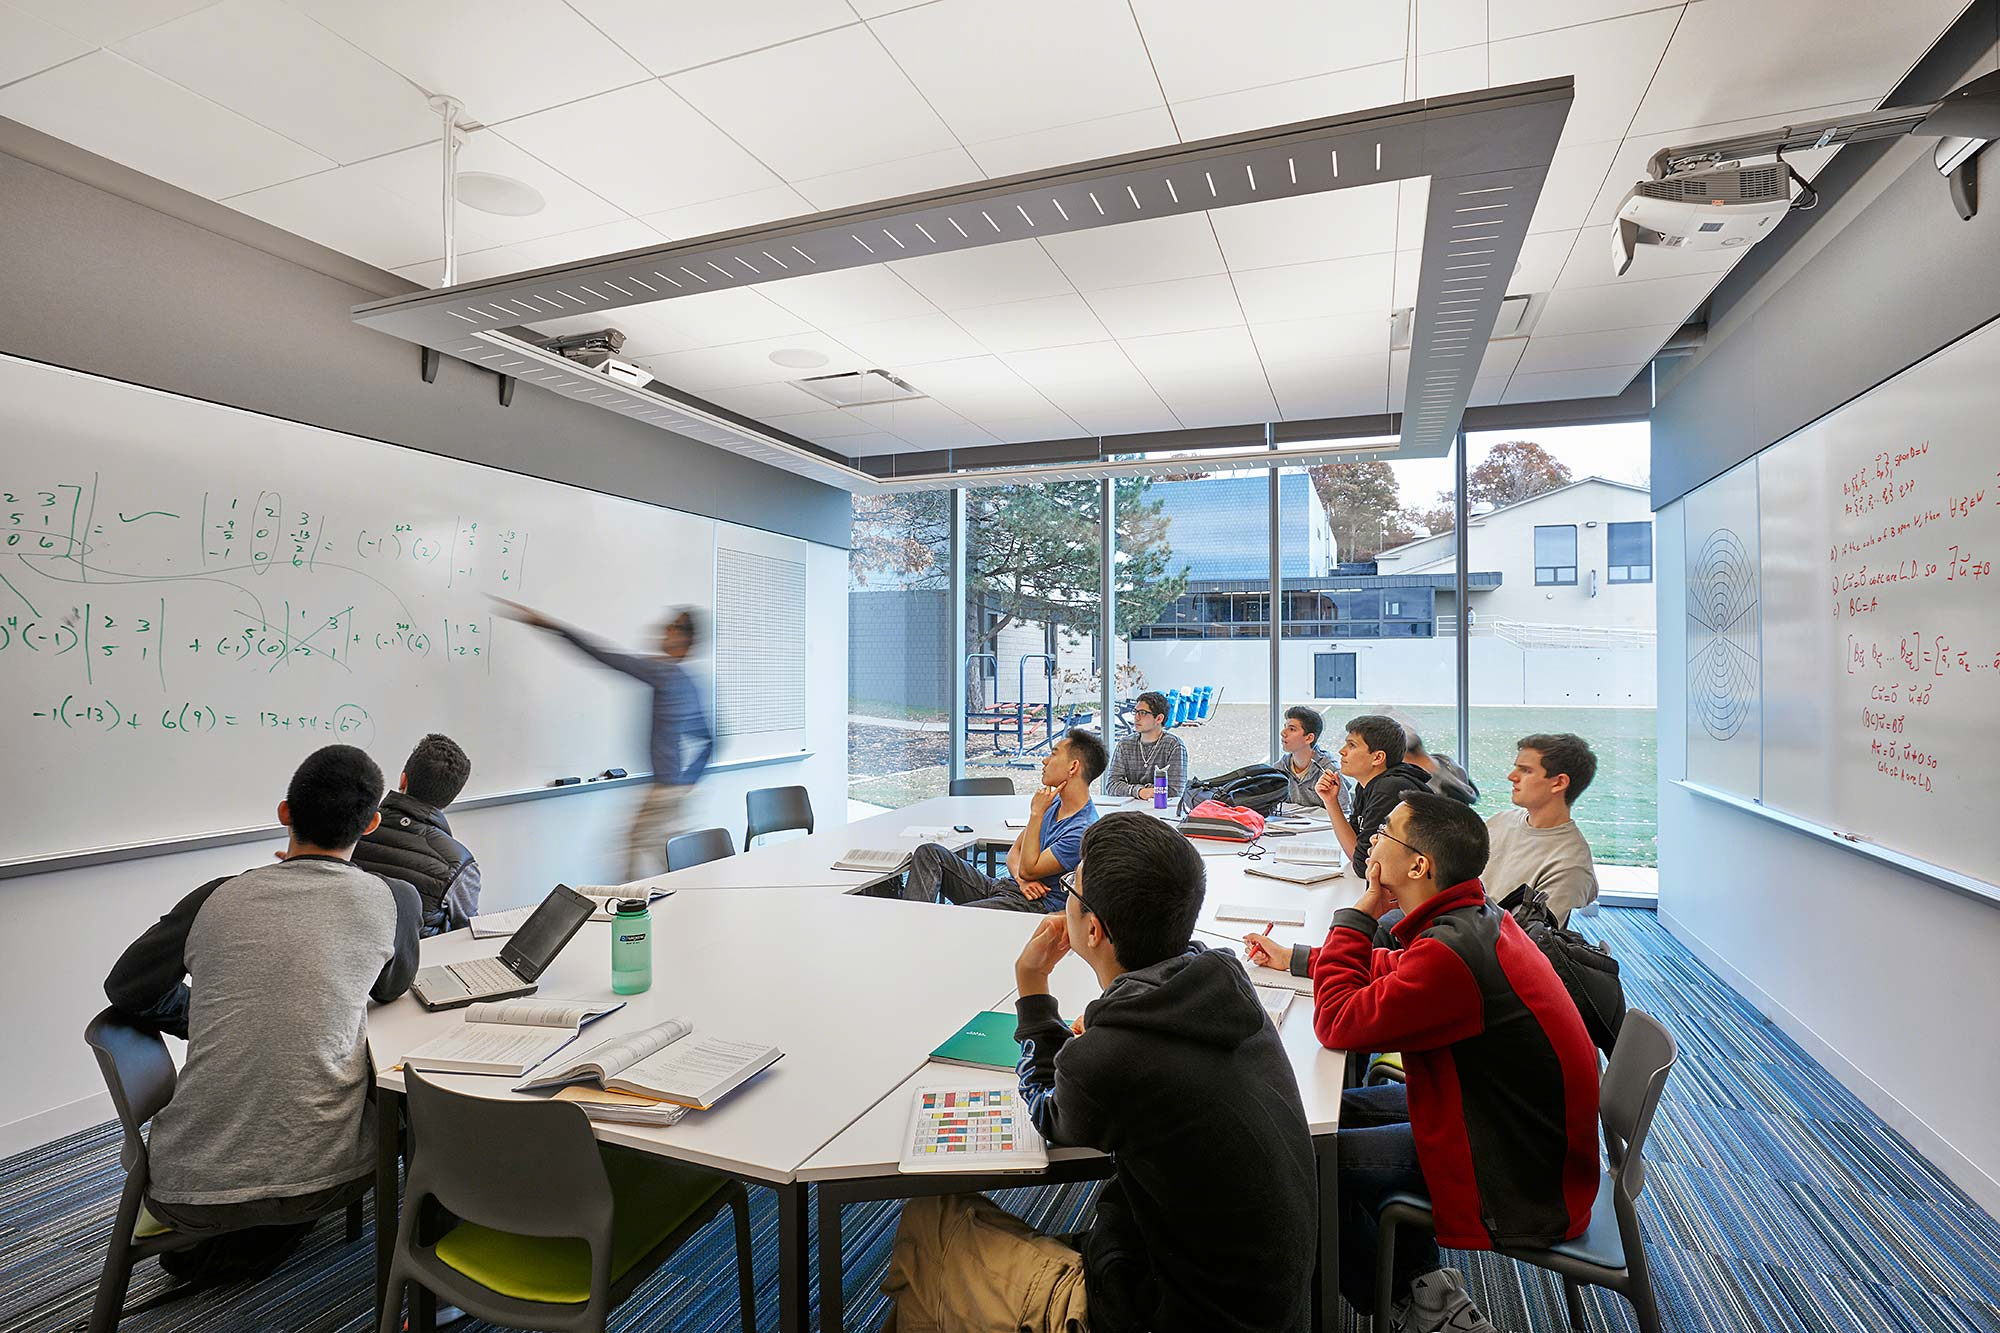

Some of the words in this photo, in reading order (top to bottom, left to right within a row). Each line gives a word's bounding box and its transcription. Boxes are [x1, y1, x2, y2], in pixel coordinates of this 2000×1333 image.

[3, 493, 20, 503] 2
[38, 492, 56, 507] 3
[10, 512, 24, 525] 5
[39, 536, 54, 549] 6
[104, 616, 117, 628] 2
[136, 619, 151, 632] 3
[101, 645, 120, 657] 5
